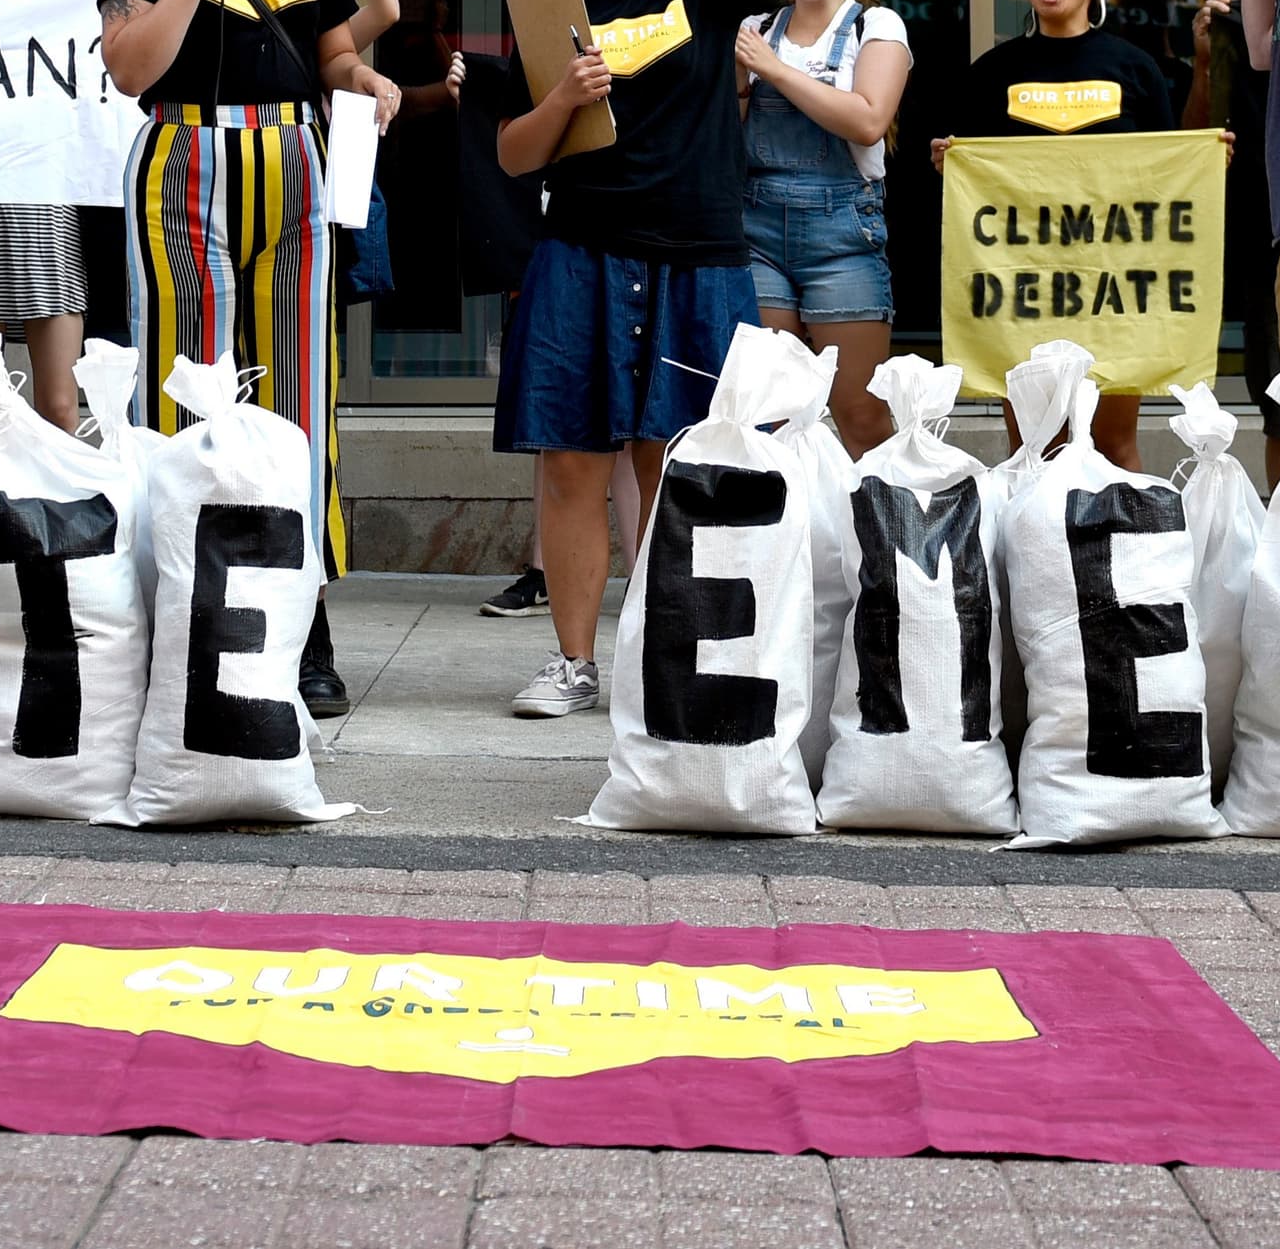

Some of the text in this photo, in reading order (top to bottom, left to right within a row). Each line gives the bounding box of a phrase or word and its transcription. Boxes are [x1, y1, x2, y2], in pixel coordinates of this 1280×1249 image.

[592, 10, 676, 49] UR TIME
[1018, 89, 1111, 104] OUR TIME
[973, 201, 1194, 246] CLIMATE
[971, 269, 1196, 319] DEBATE
[124, 960, 463, 1001] OUR
[524, 974, 928, 1016] TIME
